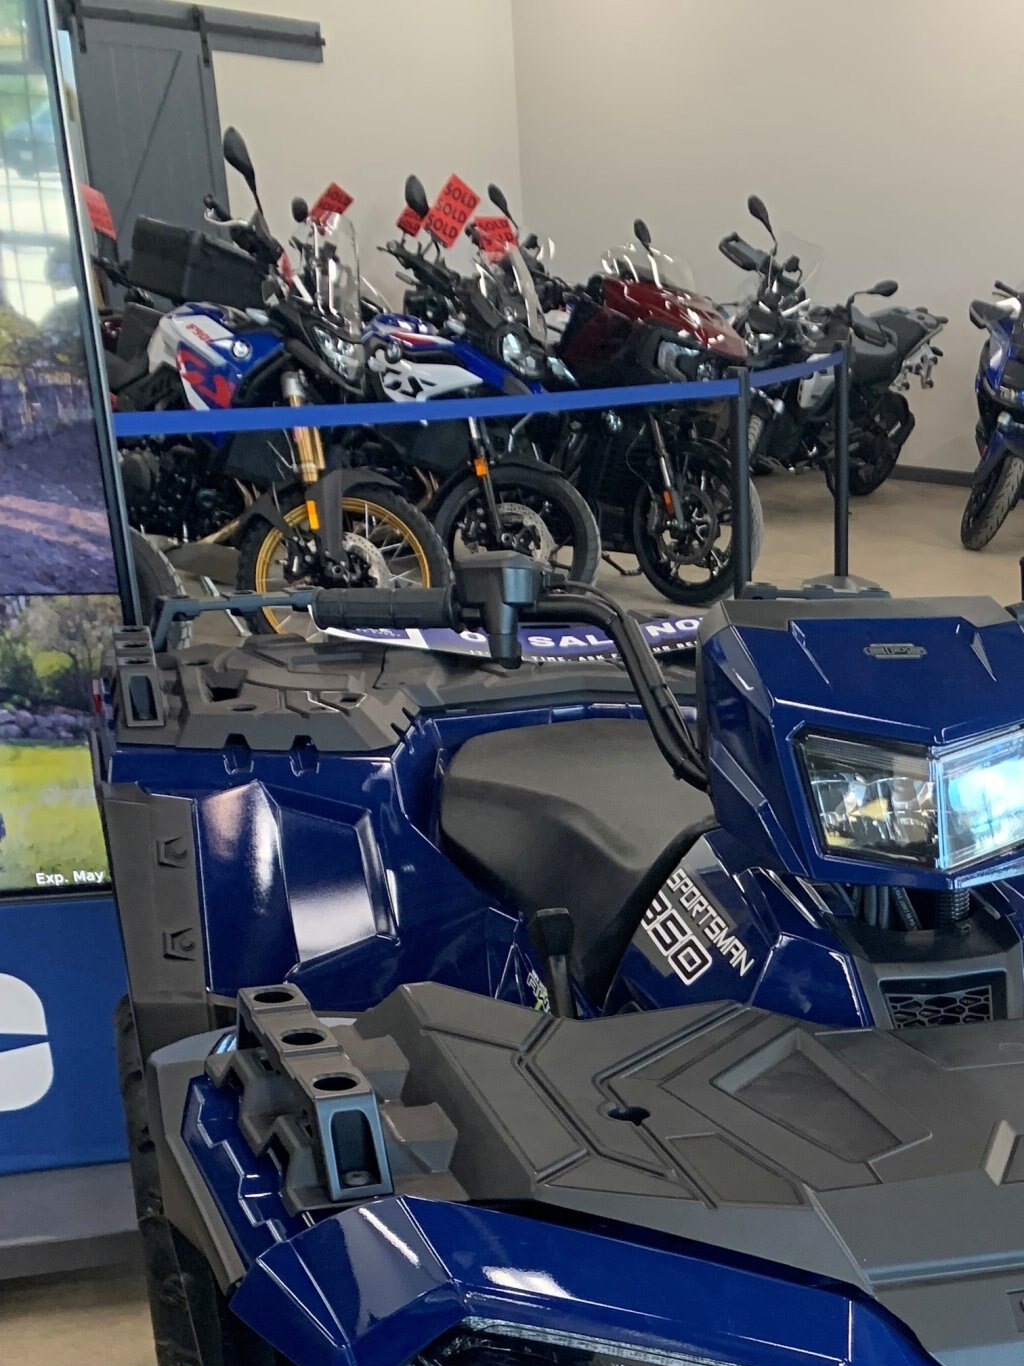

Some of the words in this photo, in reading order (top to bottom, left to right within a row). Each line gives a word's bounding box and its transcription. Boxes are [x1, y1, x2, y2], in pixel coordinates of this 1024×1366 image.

[444, 183, 477, 209] SOLD
[435, 199, 467, 224] SOLD
[426, 213, 458, 239] SOLD
[478, 218, 509, 232] SOLD
[527, 634, 614, 648] SAL
[645, 616, 703, 637] NO
[35, 872, 69, 886] Exp.
[73, 870, 104, 883] May
[666, 868, 755, 977] SPORTSMAN
